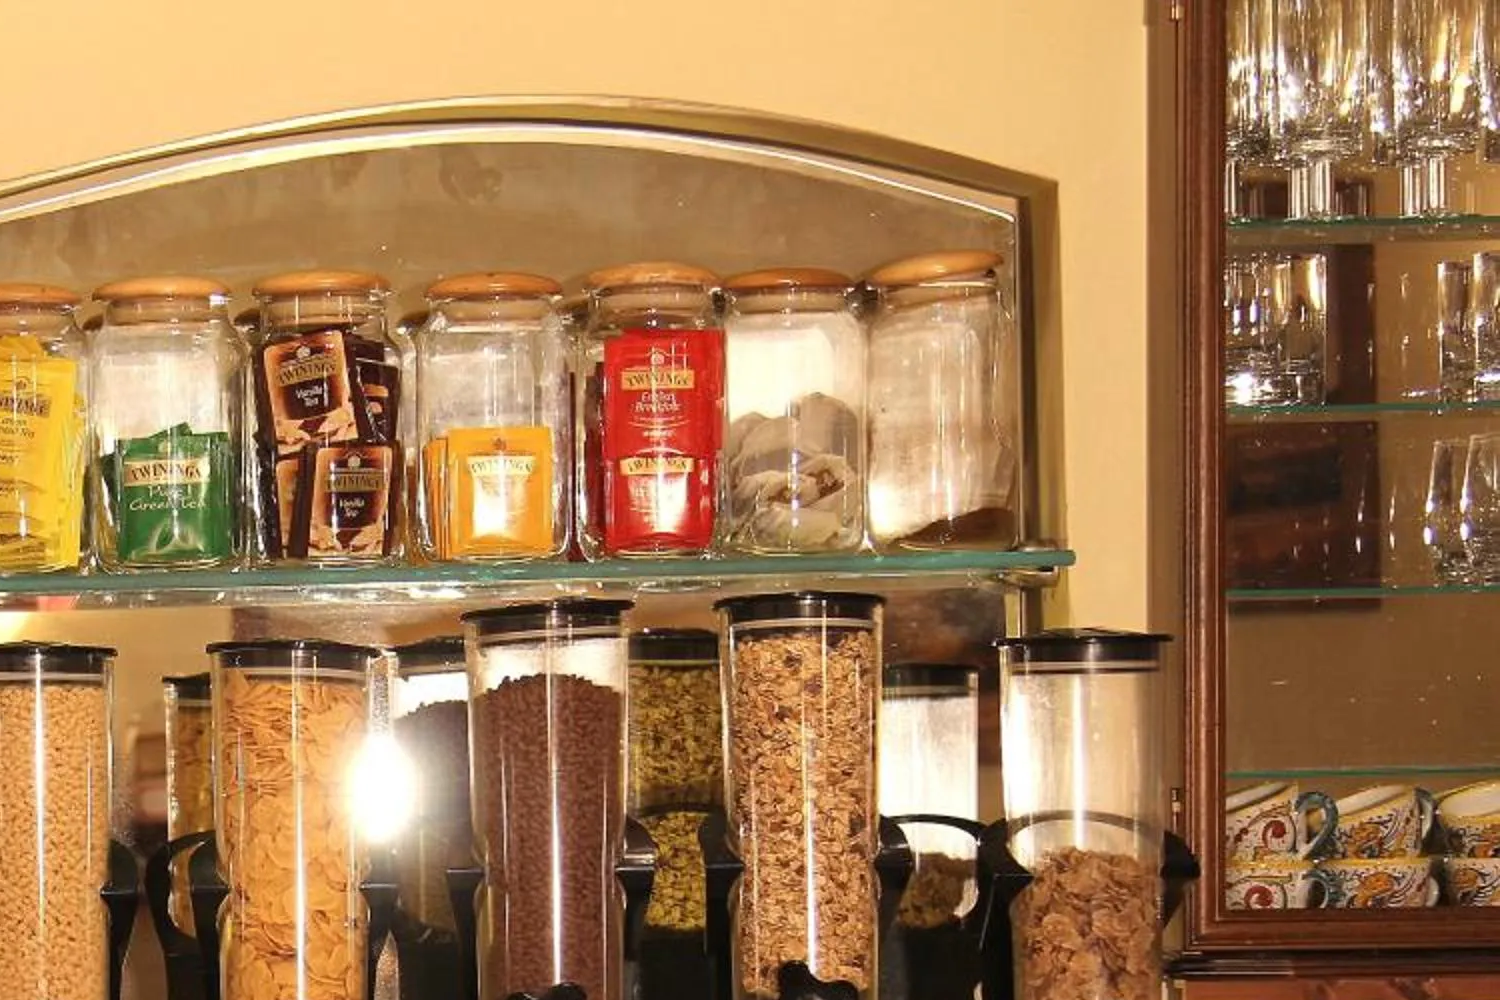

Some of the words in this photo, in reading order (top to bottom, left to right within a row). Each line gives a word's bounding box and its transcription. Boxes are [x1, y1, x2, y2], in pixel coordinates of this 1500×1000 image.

[278, 363, 337, 385] TWININGS
[626, 371, 690, 386] TWININGS
[131, 463, 201, 481] TWININGS
